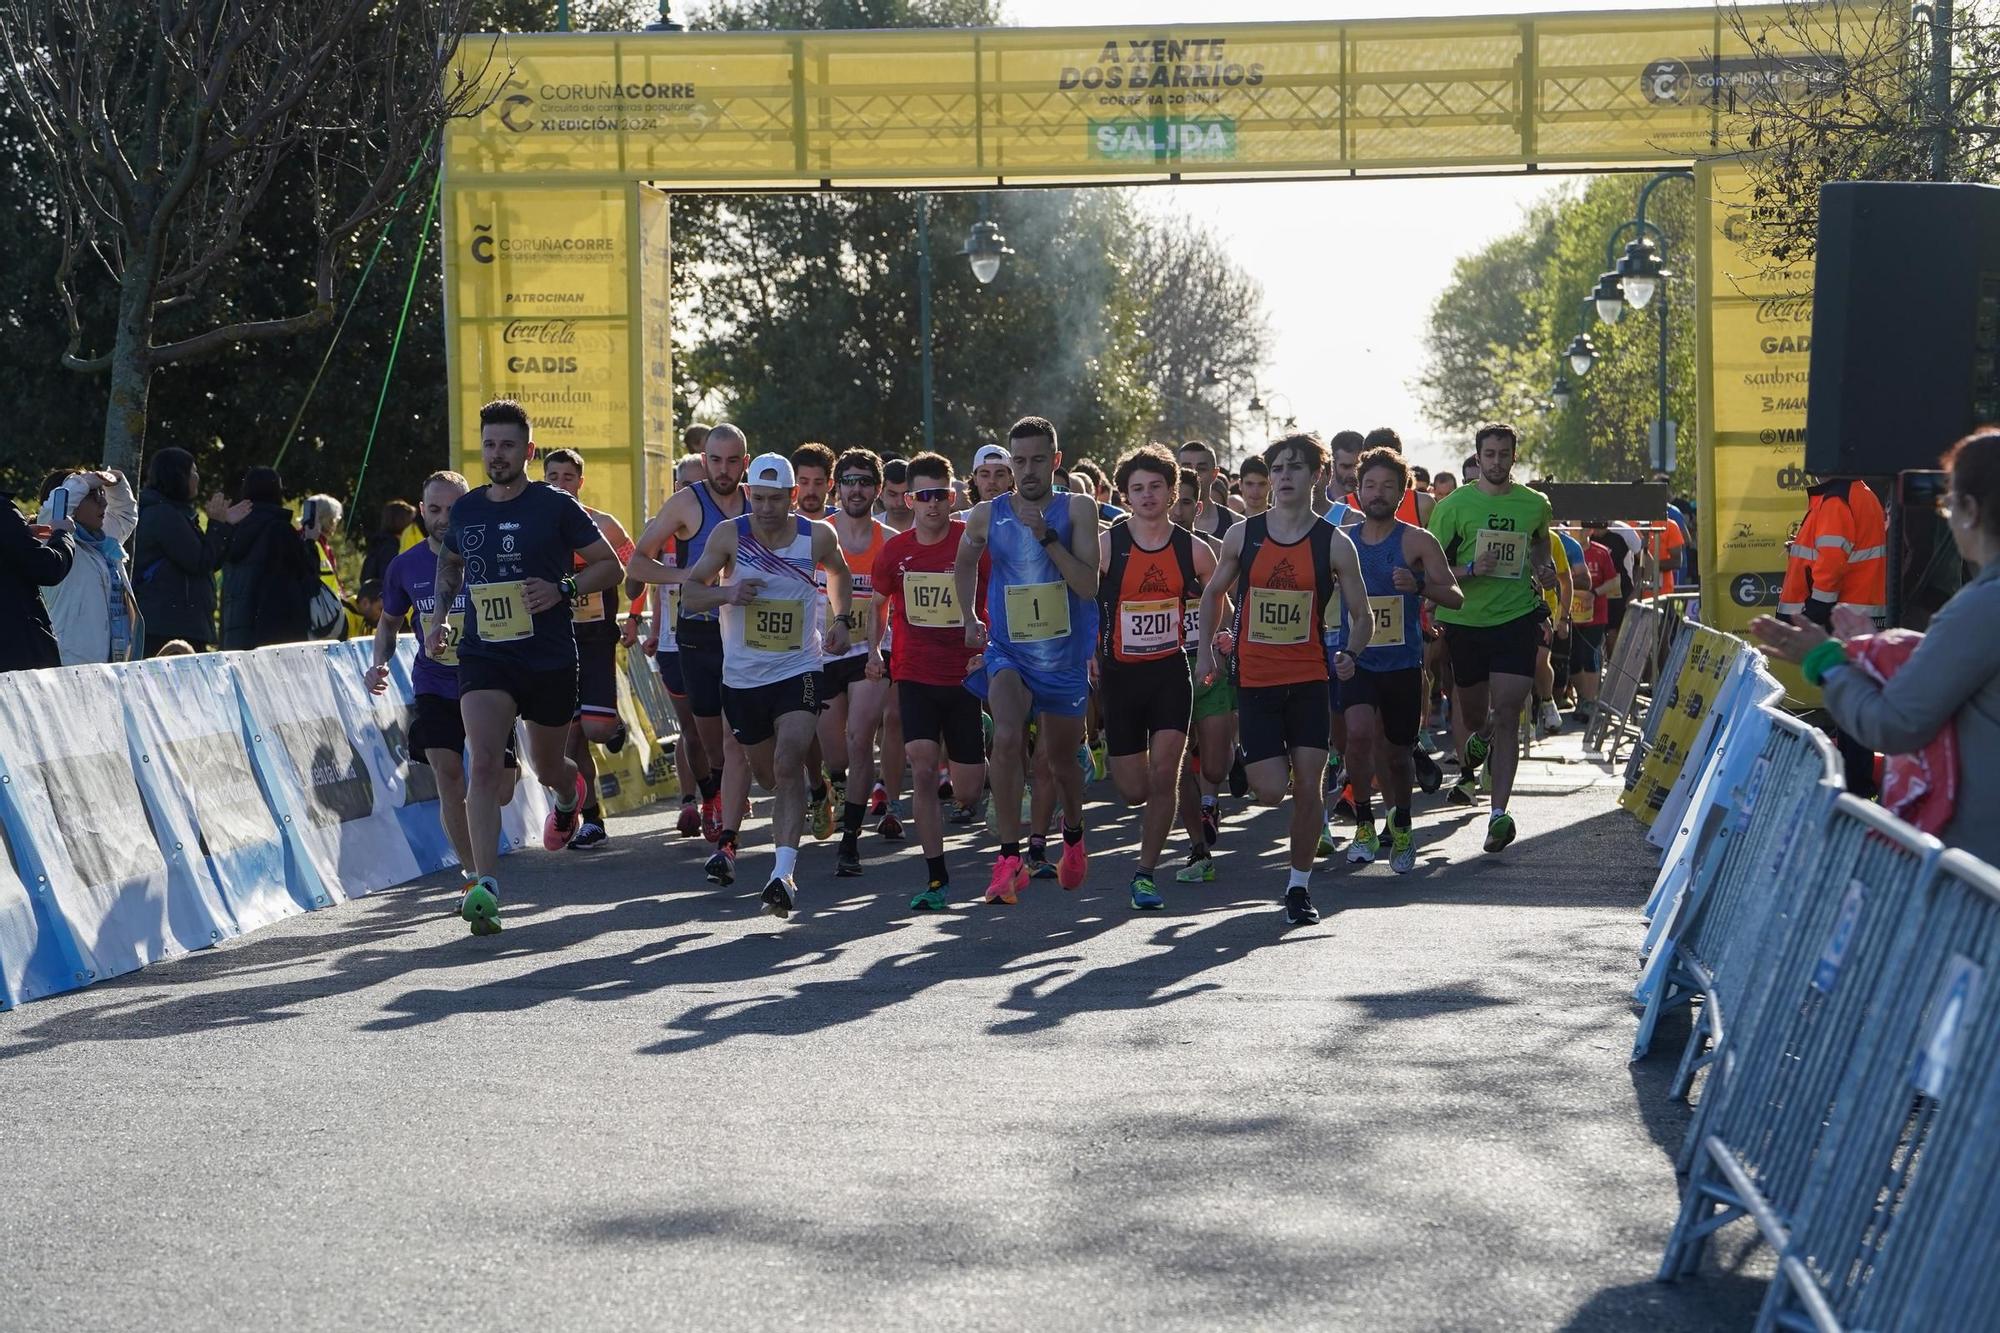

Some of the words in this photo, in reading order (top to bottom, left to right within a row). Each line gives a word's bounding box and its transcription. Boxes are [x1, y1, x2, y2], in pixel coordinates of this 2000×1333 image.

[1098, 41, 1120, 63] A
[1127, 38, 1226, 63] XENTE
[1059, 67, 1124, 89] DOS
[1128, 63, 1265, 89] BARRIOS
[540, 80, 695, 100] CORUÑACORRE
[540, 103, 579, 113] Circuito
[582, 103, 595, 112] de
[599, 103, 642, 112] carreiras
[558, 115, 619, 131] EDICIÓN
[621, 118, 658, 131] 2024
[1096, 123, 1228, 151] SALIDA
[499, 236, 614, 251] CORUÑACORRE
[505, 293, 585, 303] PATROCINAN
[503, 319, 577, 345] Coca-Cola
[508, 356, 578, 374] GADIS
[492, 385, 592, 404] sanbrandan
[913, 586, 953, 608] 1674
[481, 596, 513, 622] 201
[1032, 598, 1040, 621] 1
[1259, 602, 1301, 625] 1504
[757, 611, 793, 634] 369
[1131, 612, 1171, 636] 3201
